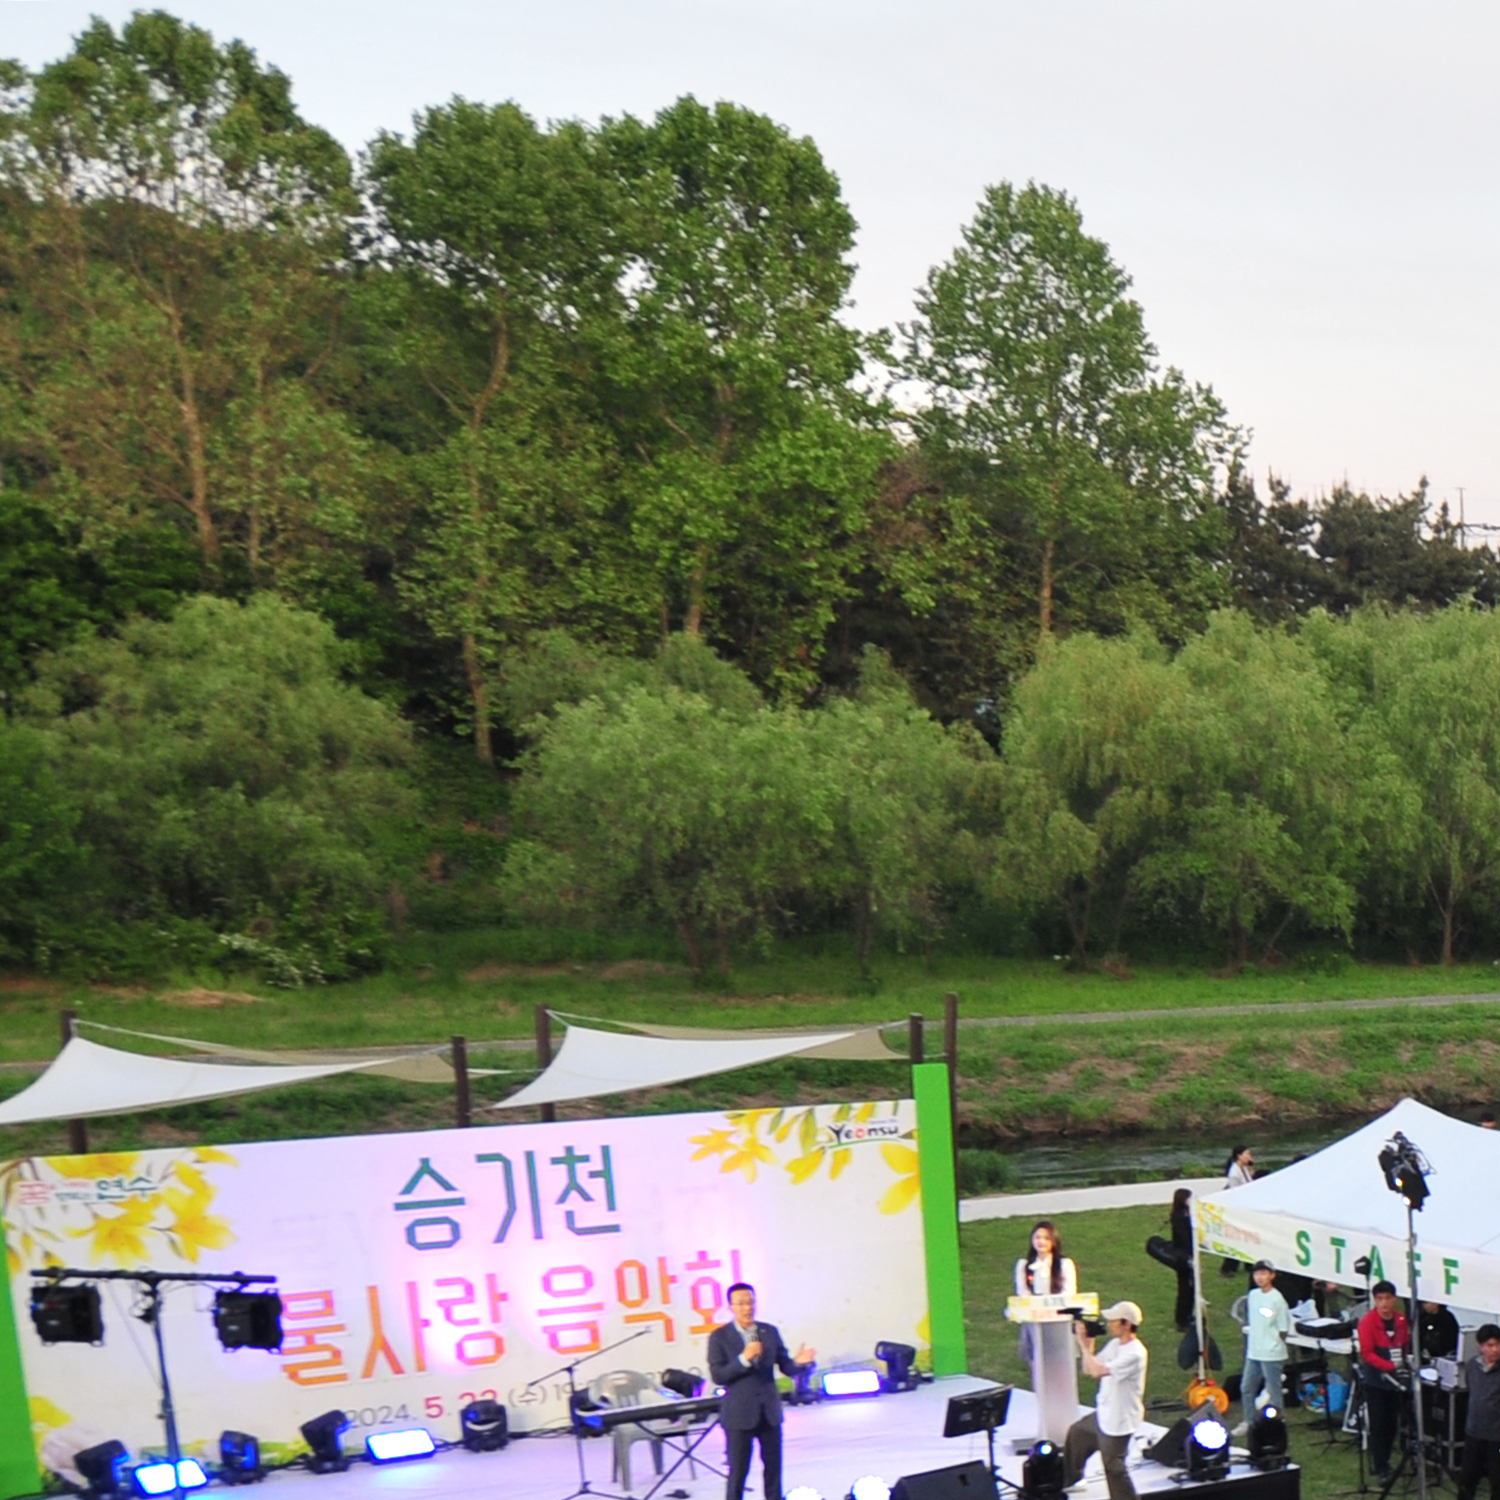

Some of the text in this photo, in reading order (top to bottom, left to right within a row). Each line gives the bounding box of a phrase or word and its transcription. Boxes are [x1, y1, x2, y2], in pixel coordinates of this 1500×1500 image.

[827, 1122, 898, 1144] Yeonsu
[96, 1176, 158, 1199] 연수
[393, 1144, 622, 1251] 승기천
[1295, 1230, 1460, 1296] STAFF
[281, 1249, 744, 1387] 물사랑 음악회
